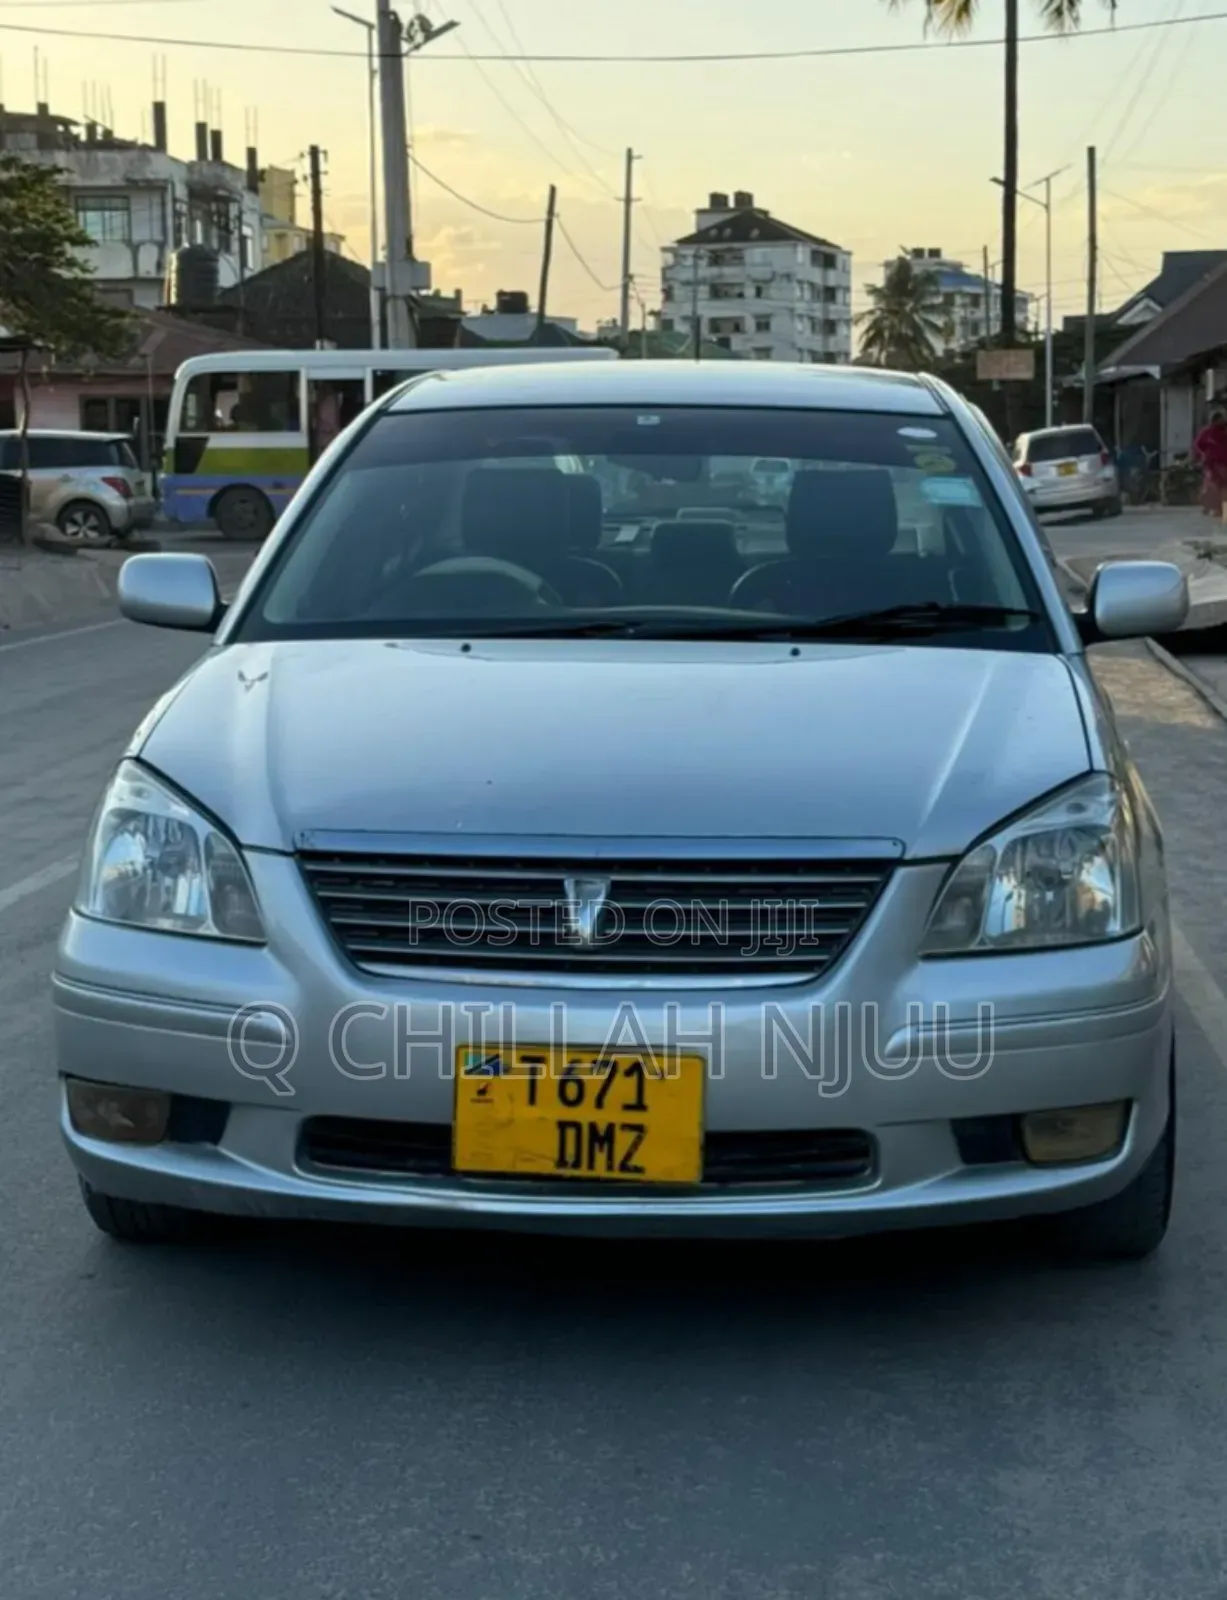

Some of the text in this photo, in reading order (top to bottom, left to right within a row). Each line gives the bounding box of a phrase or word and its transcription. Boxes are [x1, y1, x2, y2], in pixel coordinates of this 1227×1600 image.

[520, 1054, 649, 1112] T 671
[555, 1119, 648, 1174] DMZ
